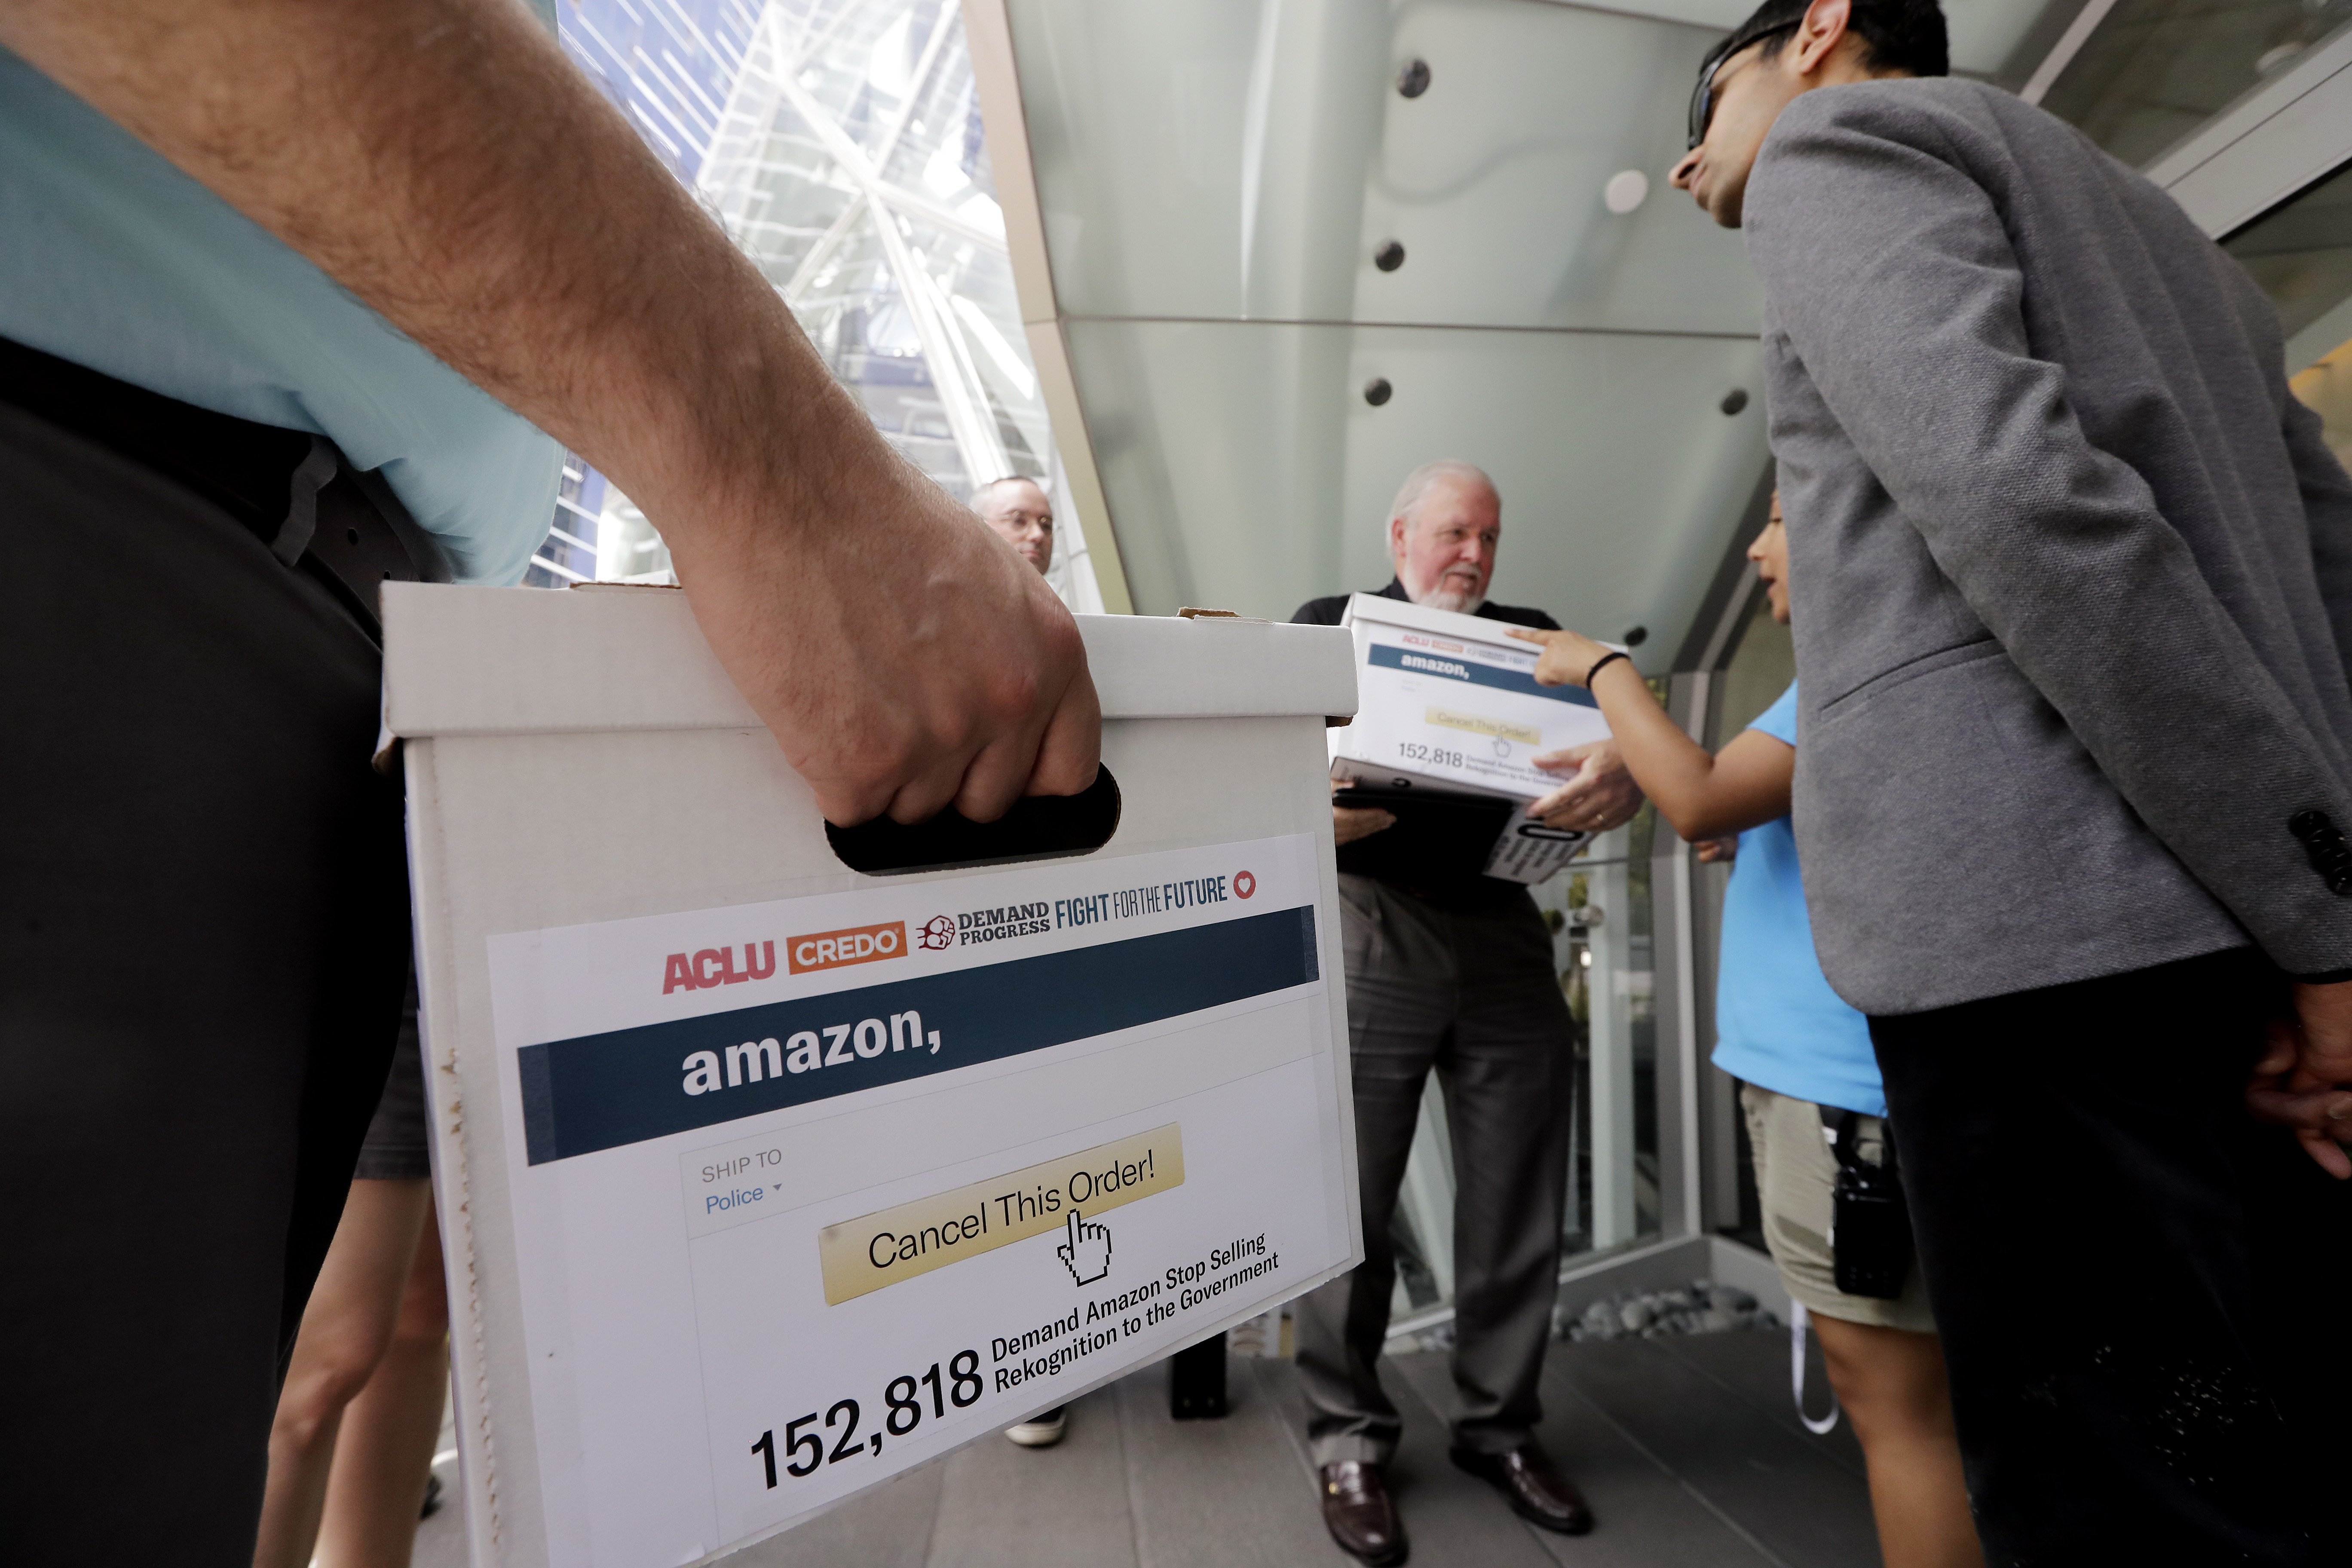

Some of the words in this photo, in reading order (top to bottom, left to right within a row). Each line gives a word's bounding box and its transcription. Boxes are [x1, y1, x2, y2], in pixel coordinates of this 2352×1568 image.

[1401, 654, 1470, 680] amazon,
[1400, 741, 1462, 768] 152,818
[957, 902, 1050, 930] DEMAND
[1055, 894, 1109, 929] FIGHT
[1164, 876, 1228, 910] FUTURE
[959, 919, 1050, 946] PROGRESS
[662, 940, 775, 995] ACLU
[682, 1010, 941, 1096] amazon,
[702, 1157, 750, 1183] SHIP
[755, 1149, 781, 1168] TO
[706, 1188, 763, 1214] Police
[869, 1202, 988, 1268] Cancel
[994, 1186, 1061, 1226] This
[1068, 1149, 1155, 1203] Order!
[992, 1307, 1079, 1363] Demand
[1086, 1280, 1161, 1325] Amazon
[1166, 1261, 1205, 1289] Stop
[1210, 1232, 1265, 1270] Selling
[995, 1327, 1117, 1393] Rekognition
[1122, 1317, 1141, 1337] to
[1146, 1301, 1175, 1326] the
[1180, 1251, 1279, 1311] Government
[751, 1349, 983, 1490] 152,818
